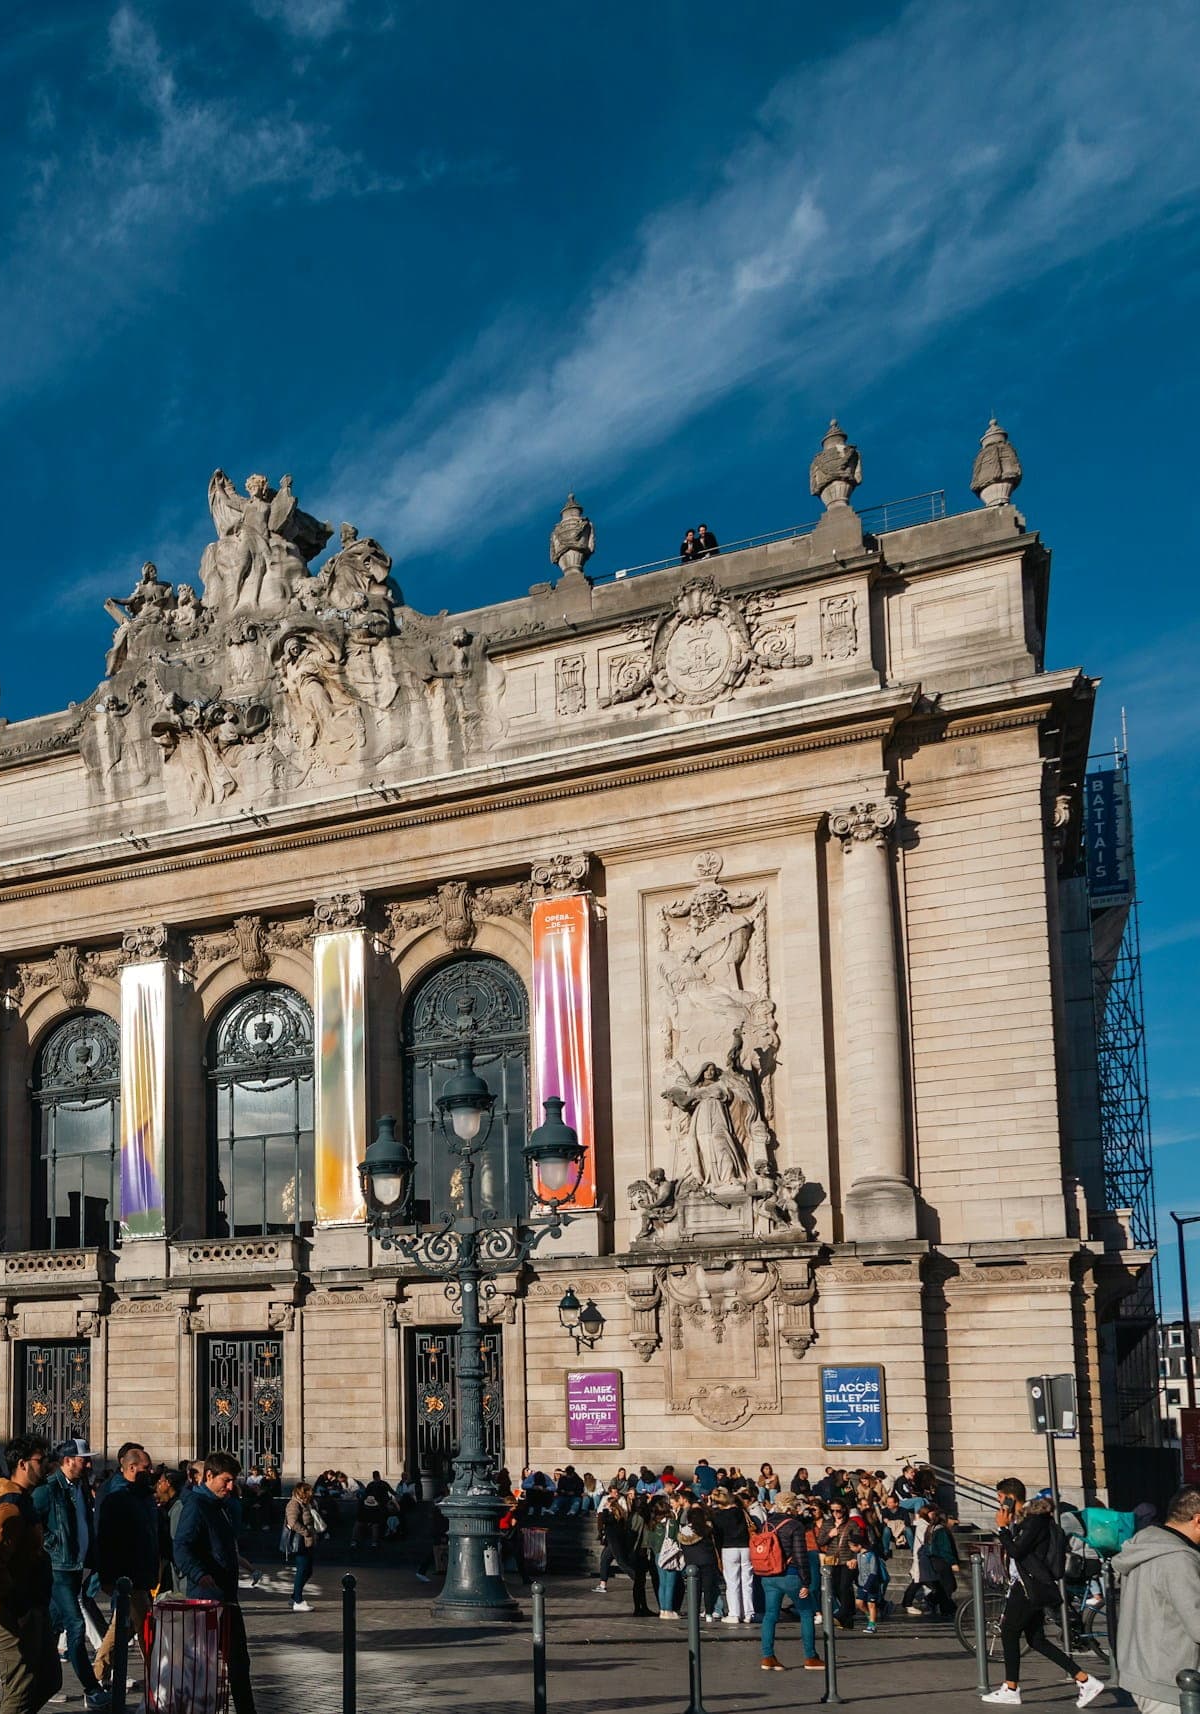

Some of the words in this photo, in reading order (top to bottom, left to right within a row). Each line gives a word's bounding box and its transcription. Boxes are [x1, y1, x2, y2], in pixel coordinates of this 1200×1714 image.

[1092, 780, 1107, 878] BATTAIS
[838, 1381, 878, 1392] ACCÈS
[597, 1394, 616, 1402] MOI
[825, 1394, 860, 1403] BILLET
[569, 1404, 588, 1412] PAR
[848, 1404, 880, 1412] TERIE
